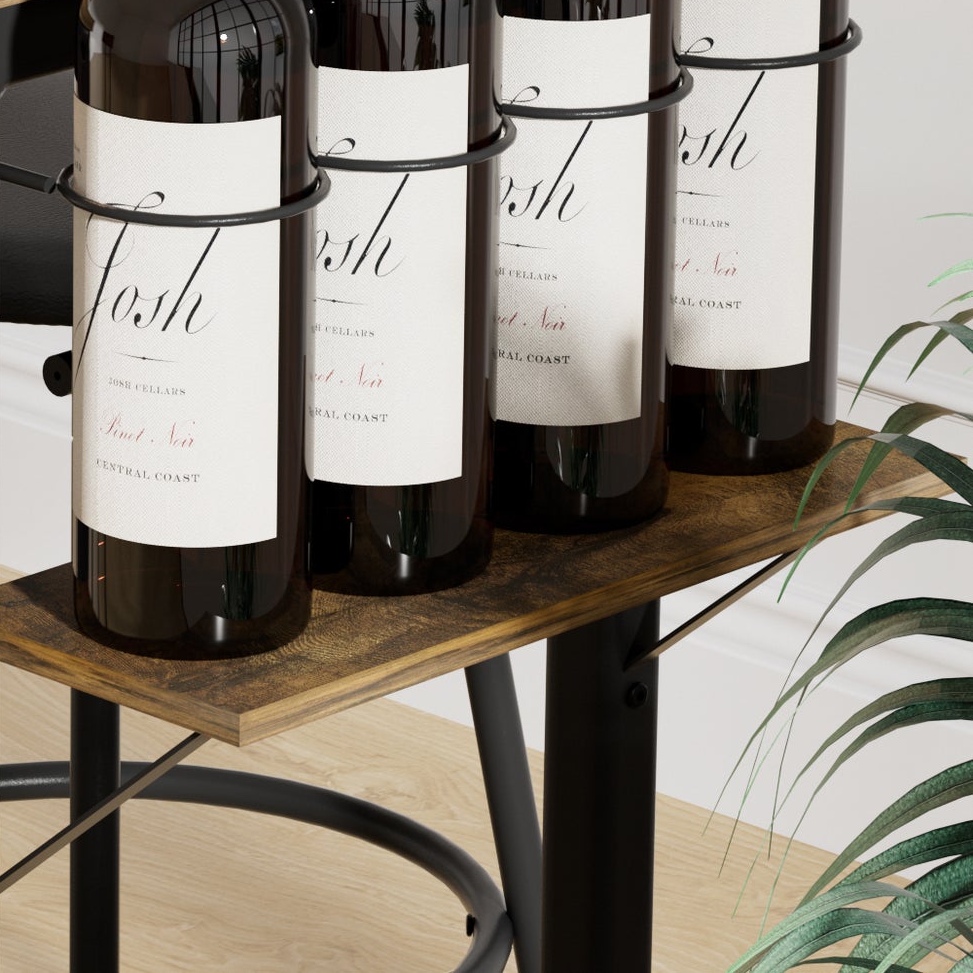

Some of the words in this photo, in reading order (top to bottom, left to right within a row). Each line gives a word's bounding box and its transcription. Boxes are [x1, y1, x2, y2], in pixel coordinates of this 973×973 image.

[682, 216, 730, 228] CELLARS
[509, 268, 558, 281] CELLARS
[699, 298, 742, 310] COAST
[325, 325, 375, 338] CELLARS
[526, 354, 571, 365] COAST
[108, 377, 131, 390] JOSH
[135, 384, 186, 396] CELLARS
[343, 412, 389, 423] COAST
[95, 458, 150, 480] CENTRAL
[155, 472, 201, 483] COAST
